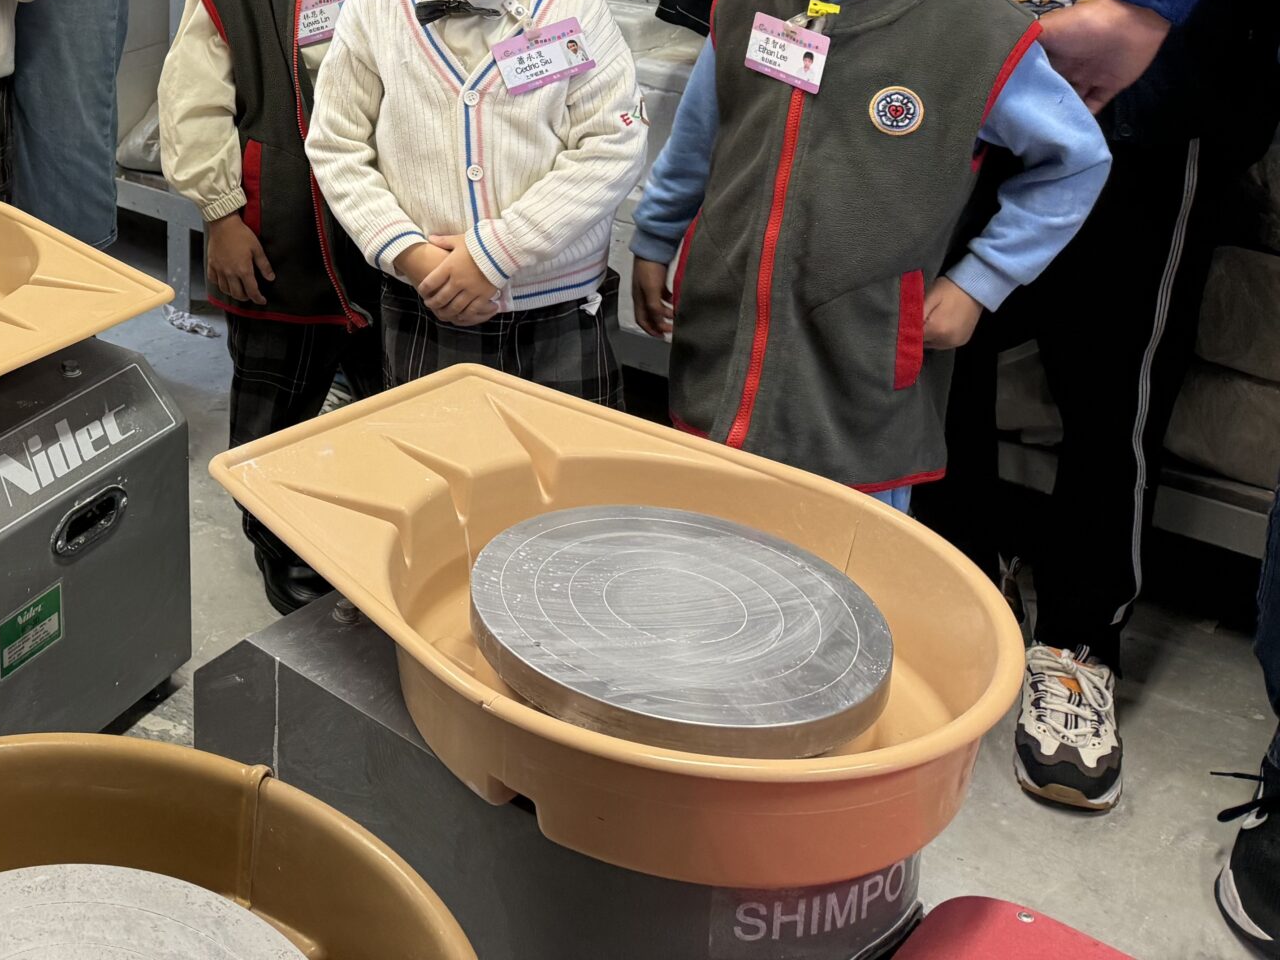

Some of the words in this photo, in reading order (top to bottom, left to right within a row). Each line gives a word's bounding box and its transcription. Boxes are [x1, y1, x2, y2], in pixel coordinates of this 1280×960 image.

[758, 44, 776, 58] Ethan
[776, 51, 788, 62] Lee
[515, 62, 540, 75] Cedric
[540, 58, 552, 67] Siu
[734, 859, 905, 941] SHIMPO
